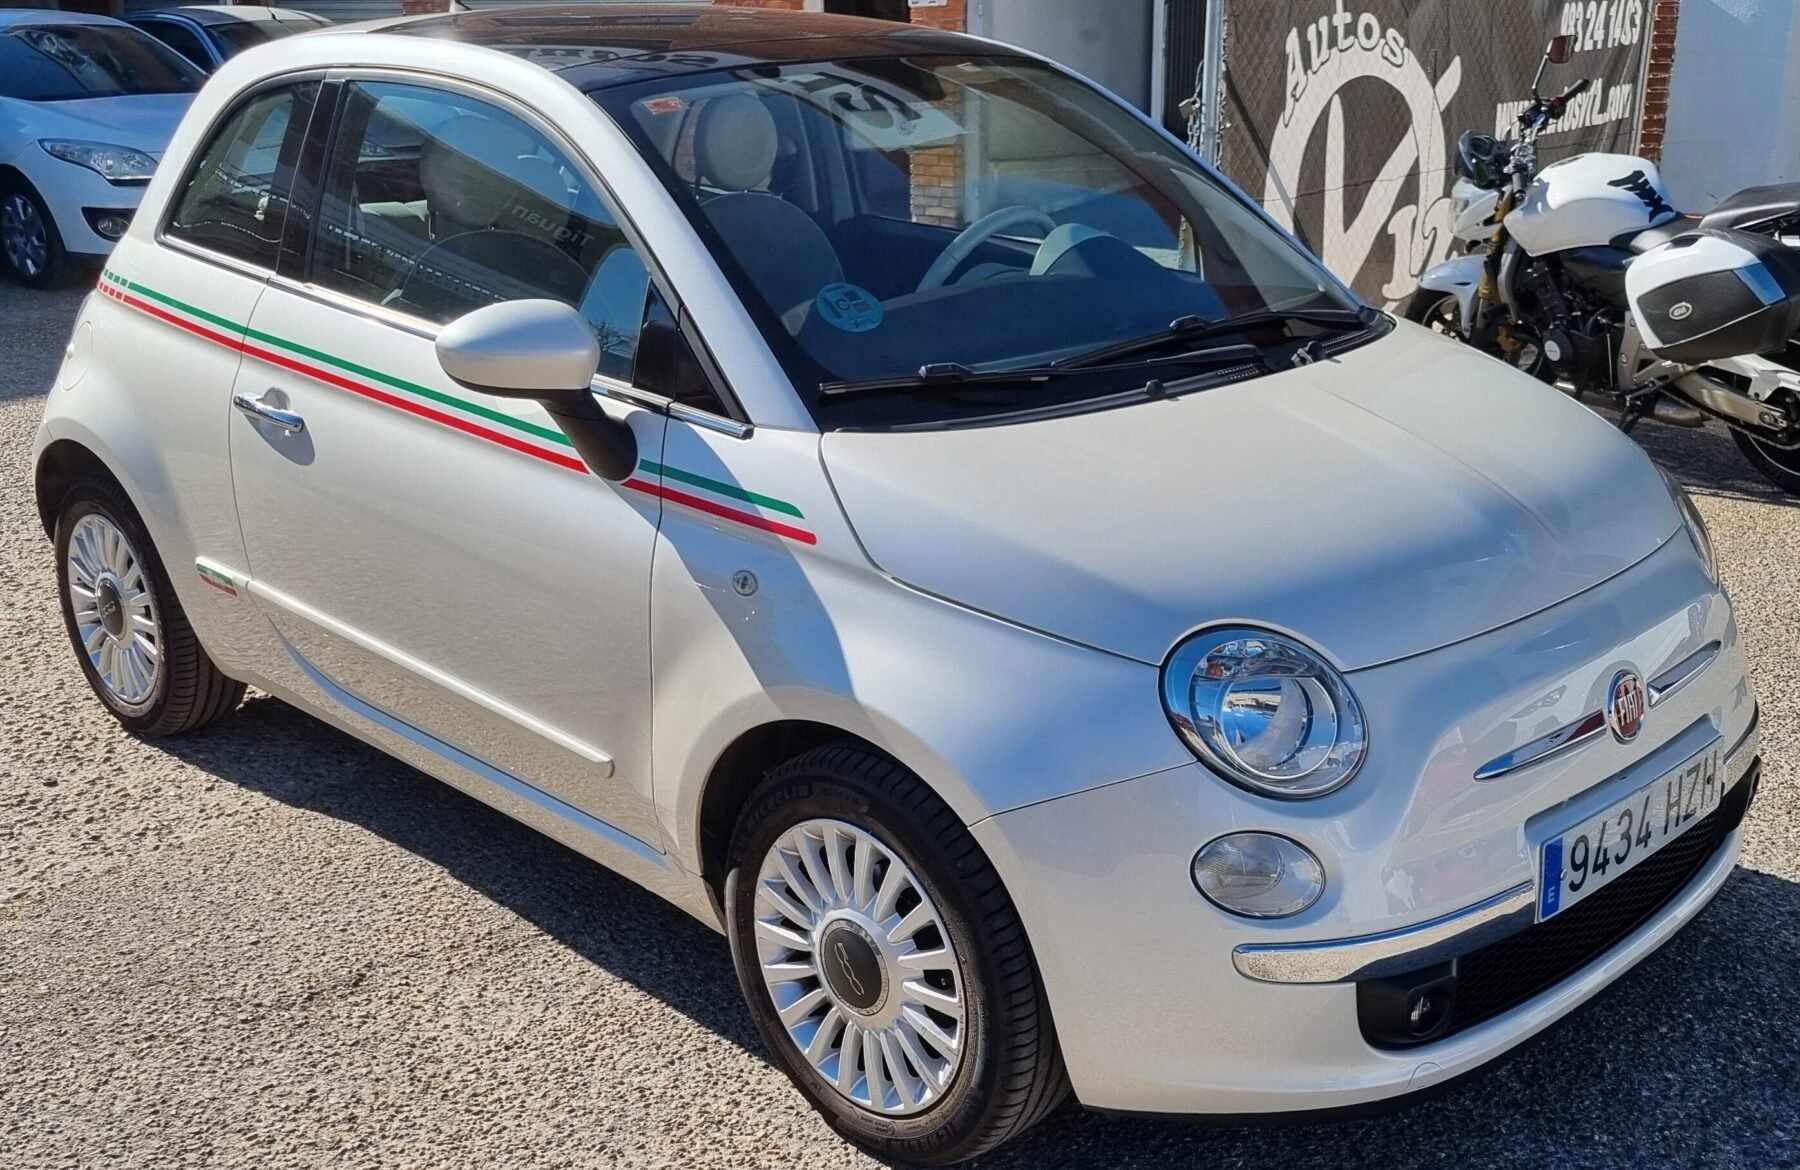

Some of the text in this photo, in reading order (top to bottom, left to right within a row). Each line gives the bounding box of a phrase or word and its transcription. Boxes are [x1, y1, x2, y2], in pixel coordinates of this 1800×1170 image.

[1584, 1, 1608, 51] 24
[1284, 0, 1405, 128] Autos
[1617, 689, 1640, 727] FIAT
[1569, 750, 1718, 892] 9434 HZH
[1547, 886, 1556, 904] E
